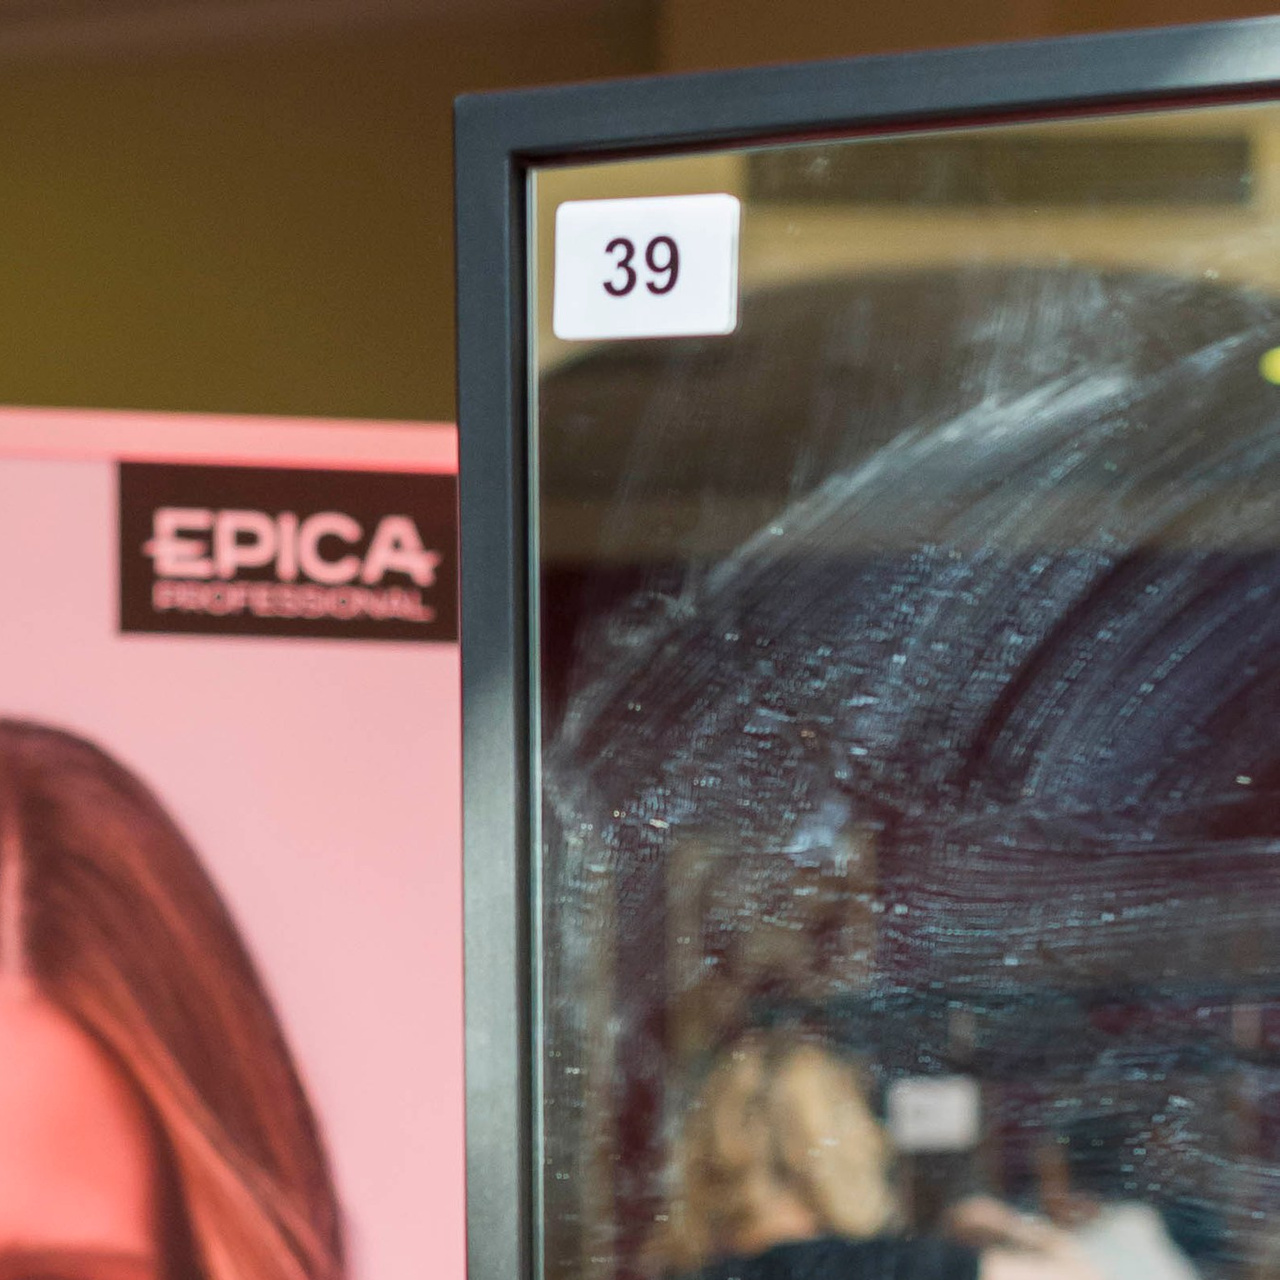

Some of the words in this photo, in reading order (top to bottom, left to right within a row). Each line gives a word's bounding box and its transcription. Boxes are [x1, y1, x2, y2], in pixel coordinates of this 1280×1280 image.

[603, 235, 680, 296] 39
[143, 507, 440, 587] EPICA
[152, 581, 435, 621] PROFESSIONAL
